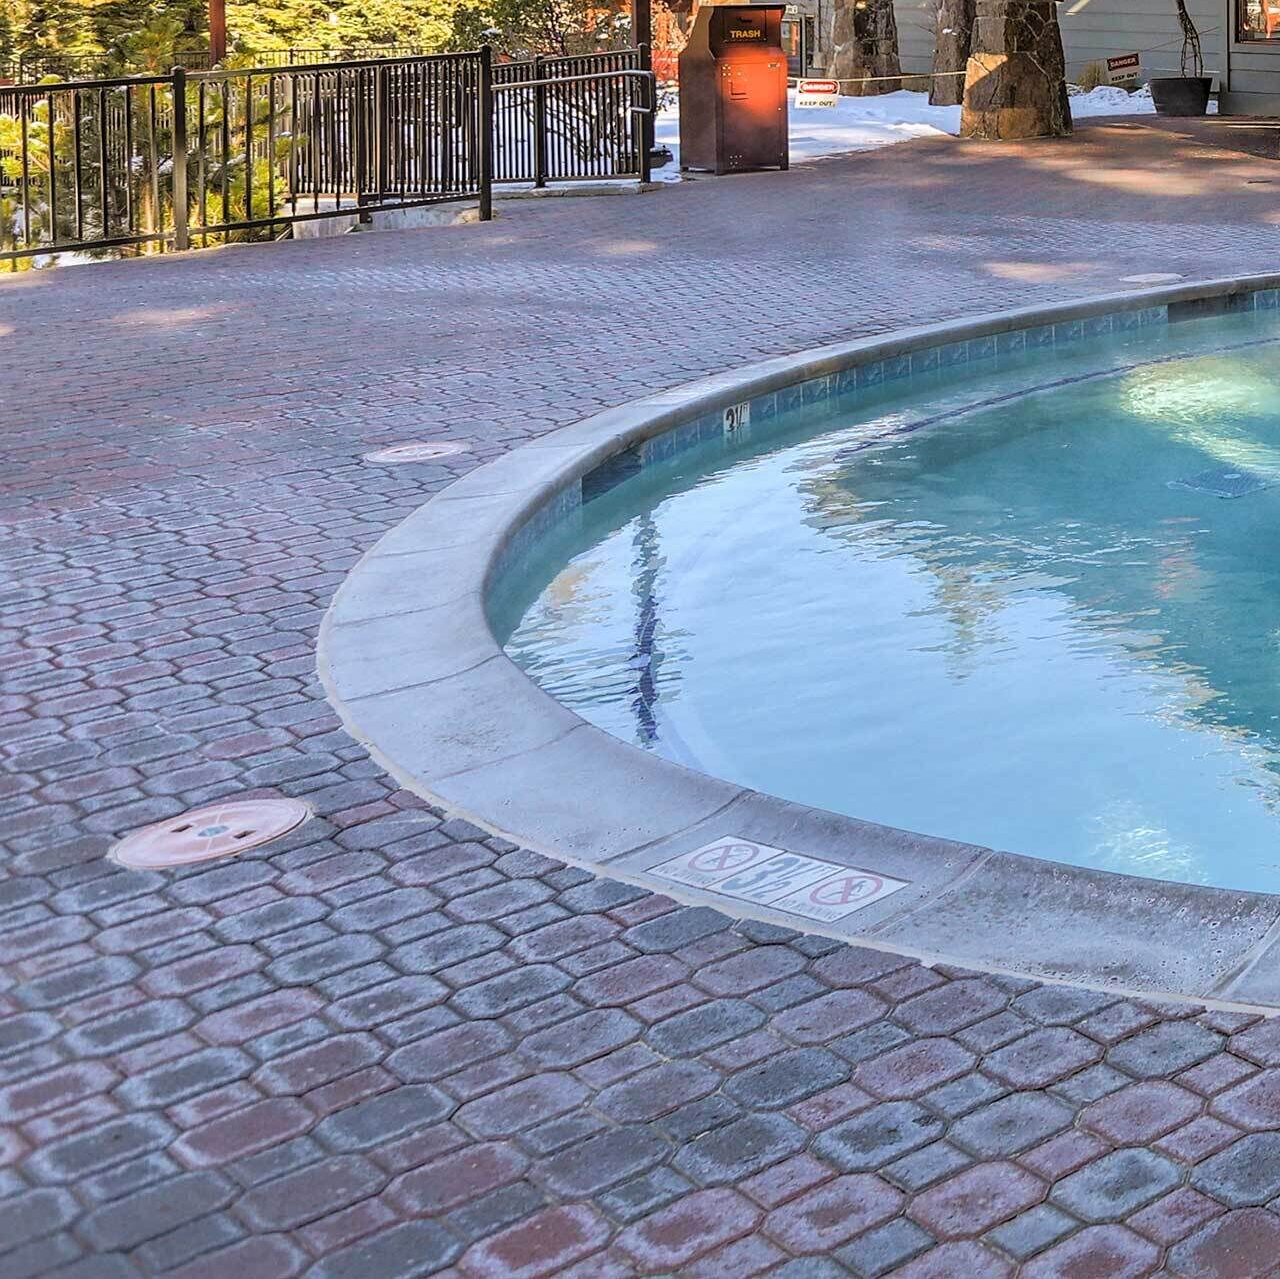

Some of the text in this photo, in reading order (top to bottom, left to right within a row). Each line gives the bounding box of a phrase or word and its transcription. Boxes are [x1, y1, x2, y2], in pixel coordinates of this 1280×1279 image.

[730, 30, 761, 39] TRASH
[1110, 57, 1136, 68] DANGER
[802, 83, 836, 92] DANGER
